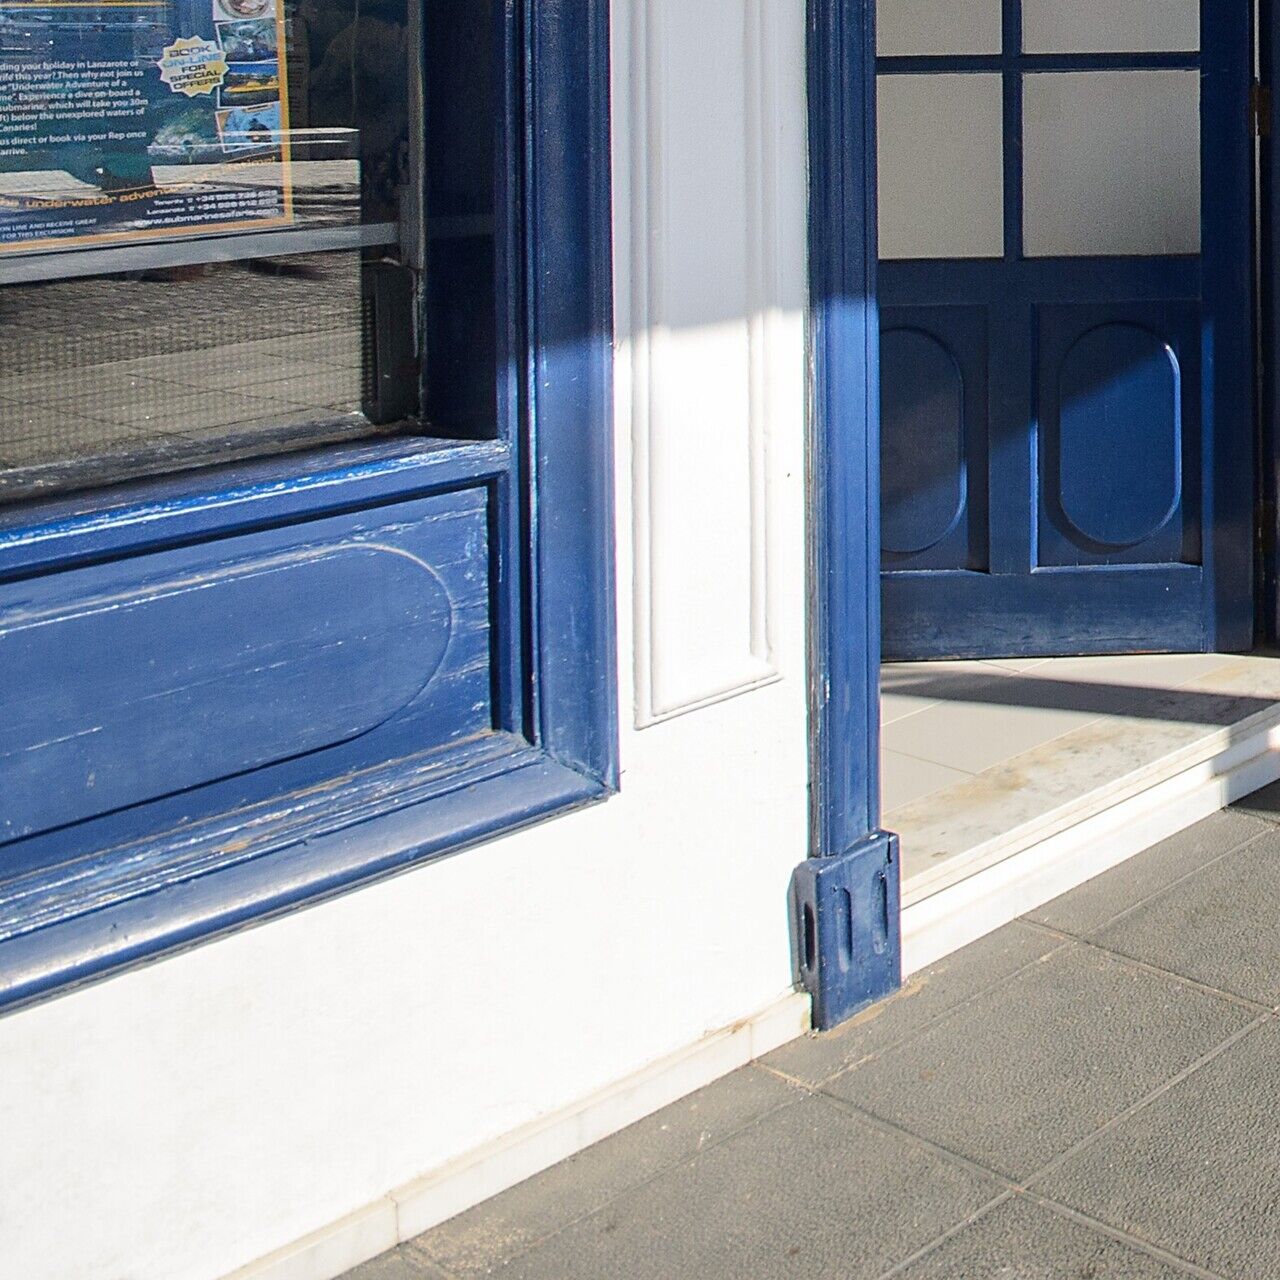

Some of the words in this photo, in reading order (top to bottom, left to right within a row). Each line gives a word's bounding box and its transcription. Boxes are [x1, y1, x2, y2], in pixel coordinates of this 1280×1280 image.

[169, 44, 211, 58] BOOK
[21, 63, 42, 72] your
[42, 61, 76, 71] holiday
[76, 61, 86, 69] in
[87, 60, 129, 68] Lanzarote
[181, 63, 206, 73] FOR
[15, 72, 32, 81] this
[33, 71, 56, 82] year?
[57, 70, 79, 79] Then
[80, 70, 99, 80] why
[100, 70, 115, 78] not
[116, 70, 133, 79] join
[170, 70, 221, 83] SPECIAL
[65, 80, 110, 89] Adventure
[111, 79, 120, 87] of
[173, 77, 221, 90] OFFERS
[19, 92, 66, 101] Experience
[74, 90, 93, 98] dive
[48, 101, 75, 109] which
[76, 100, 91, 108] will
[92, 100, 111, 108] take
[112, 100, 129, 108] you
[11, 112, 38, 121] below
[39, 111, 55, 120] the
[55, 109, 105, 120] unexplored
[106, 109, 134, 117] waters
[135, 107, 145, 115] of
[11, 137, 37, 145] direct
[38, 136, 48, 144] or
[49, 134, 72, 143] book
[73, 133, 86, 141] via
[87, 133, 107, 142] your
[108, 131, 125, 140] Rep
[126, 131, 147, 139] once
[25, 195, 117, 208] underwater
